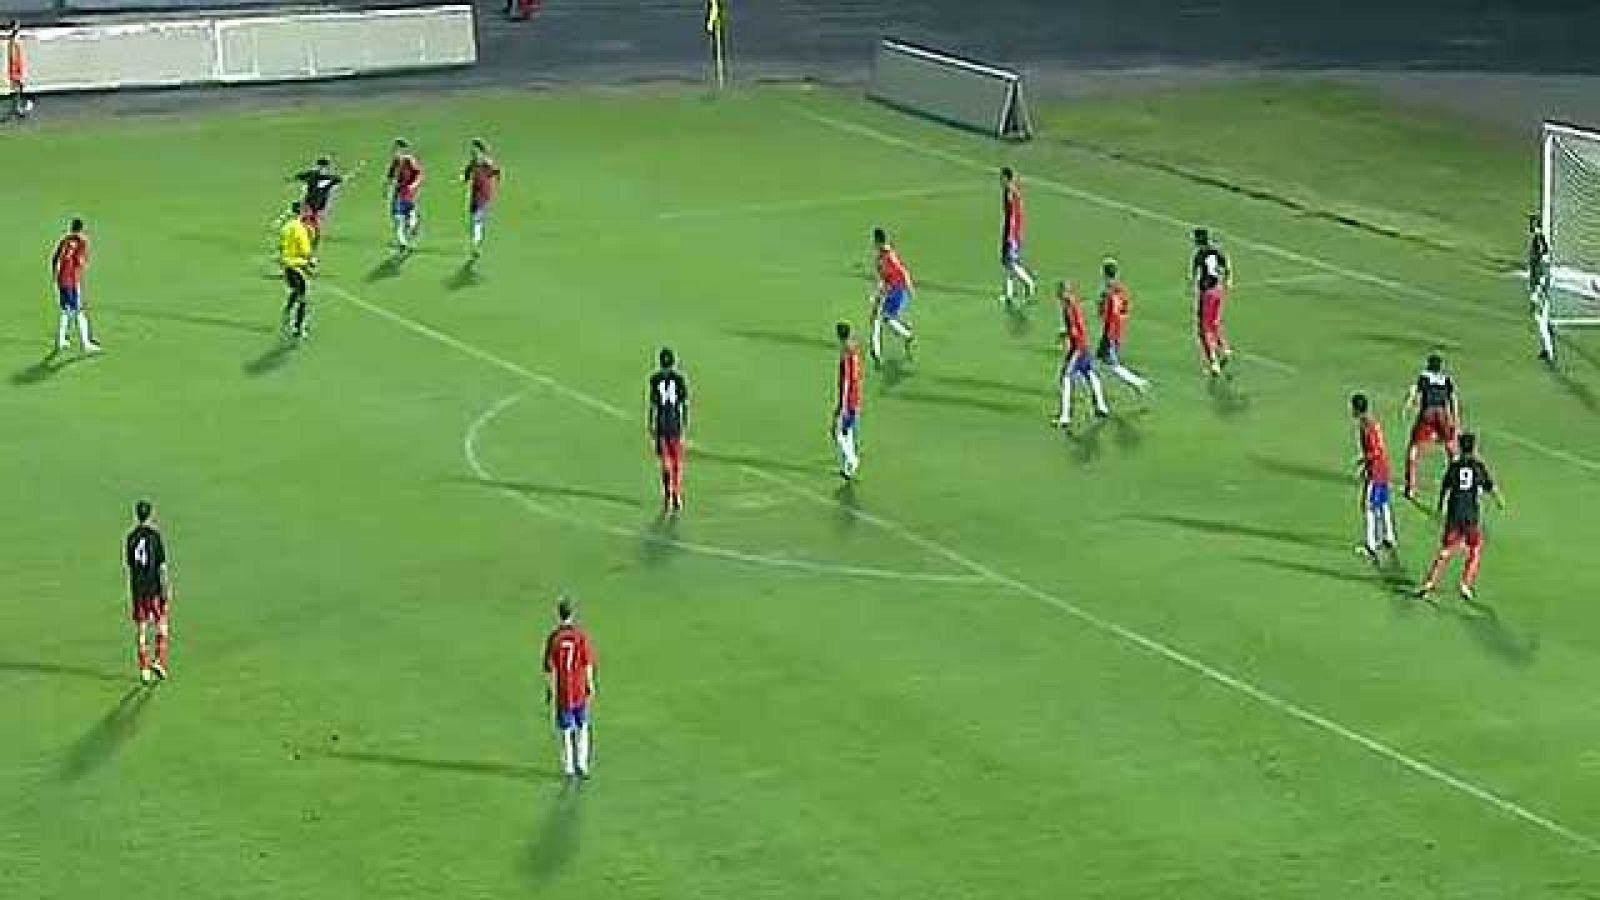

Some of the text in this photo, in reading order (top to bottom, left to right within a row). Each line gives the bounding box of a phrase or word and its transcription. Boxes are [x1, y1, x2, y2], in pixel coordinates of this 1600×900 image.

[659, 379, 677, 405] 14
[1460, 467, 1473, 490] 9
[135, 538, 148, 566] 4
[561, 641, 575, 671] 7
